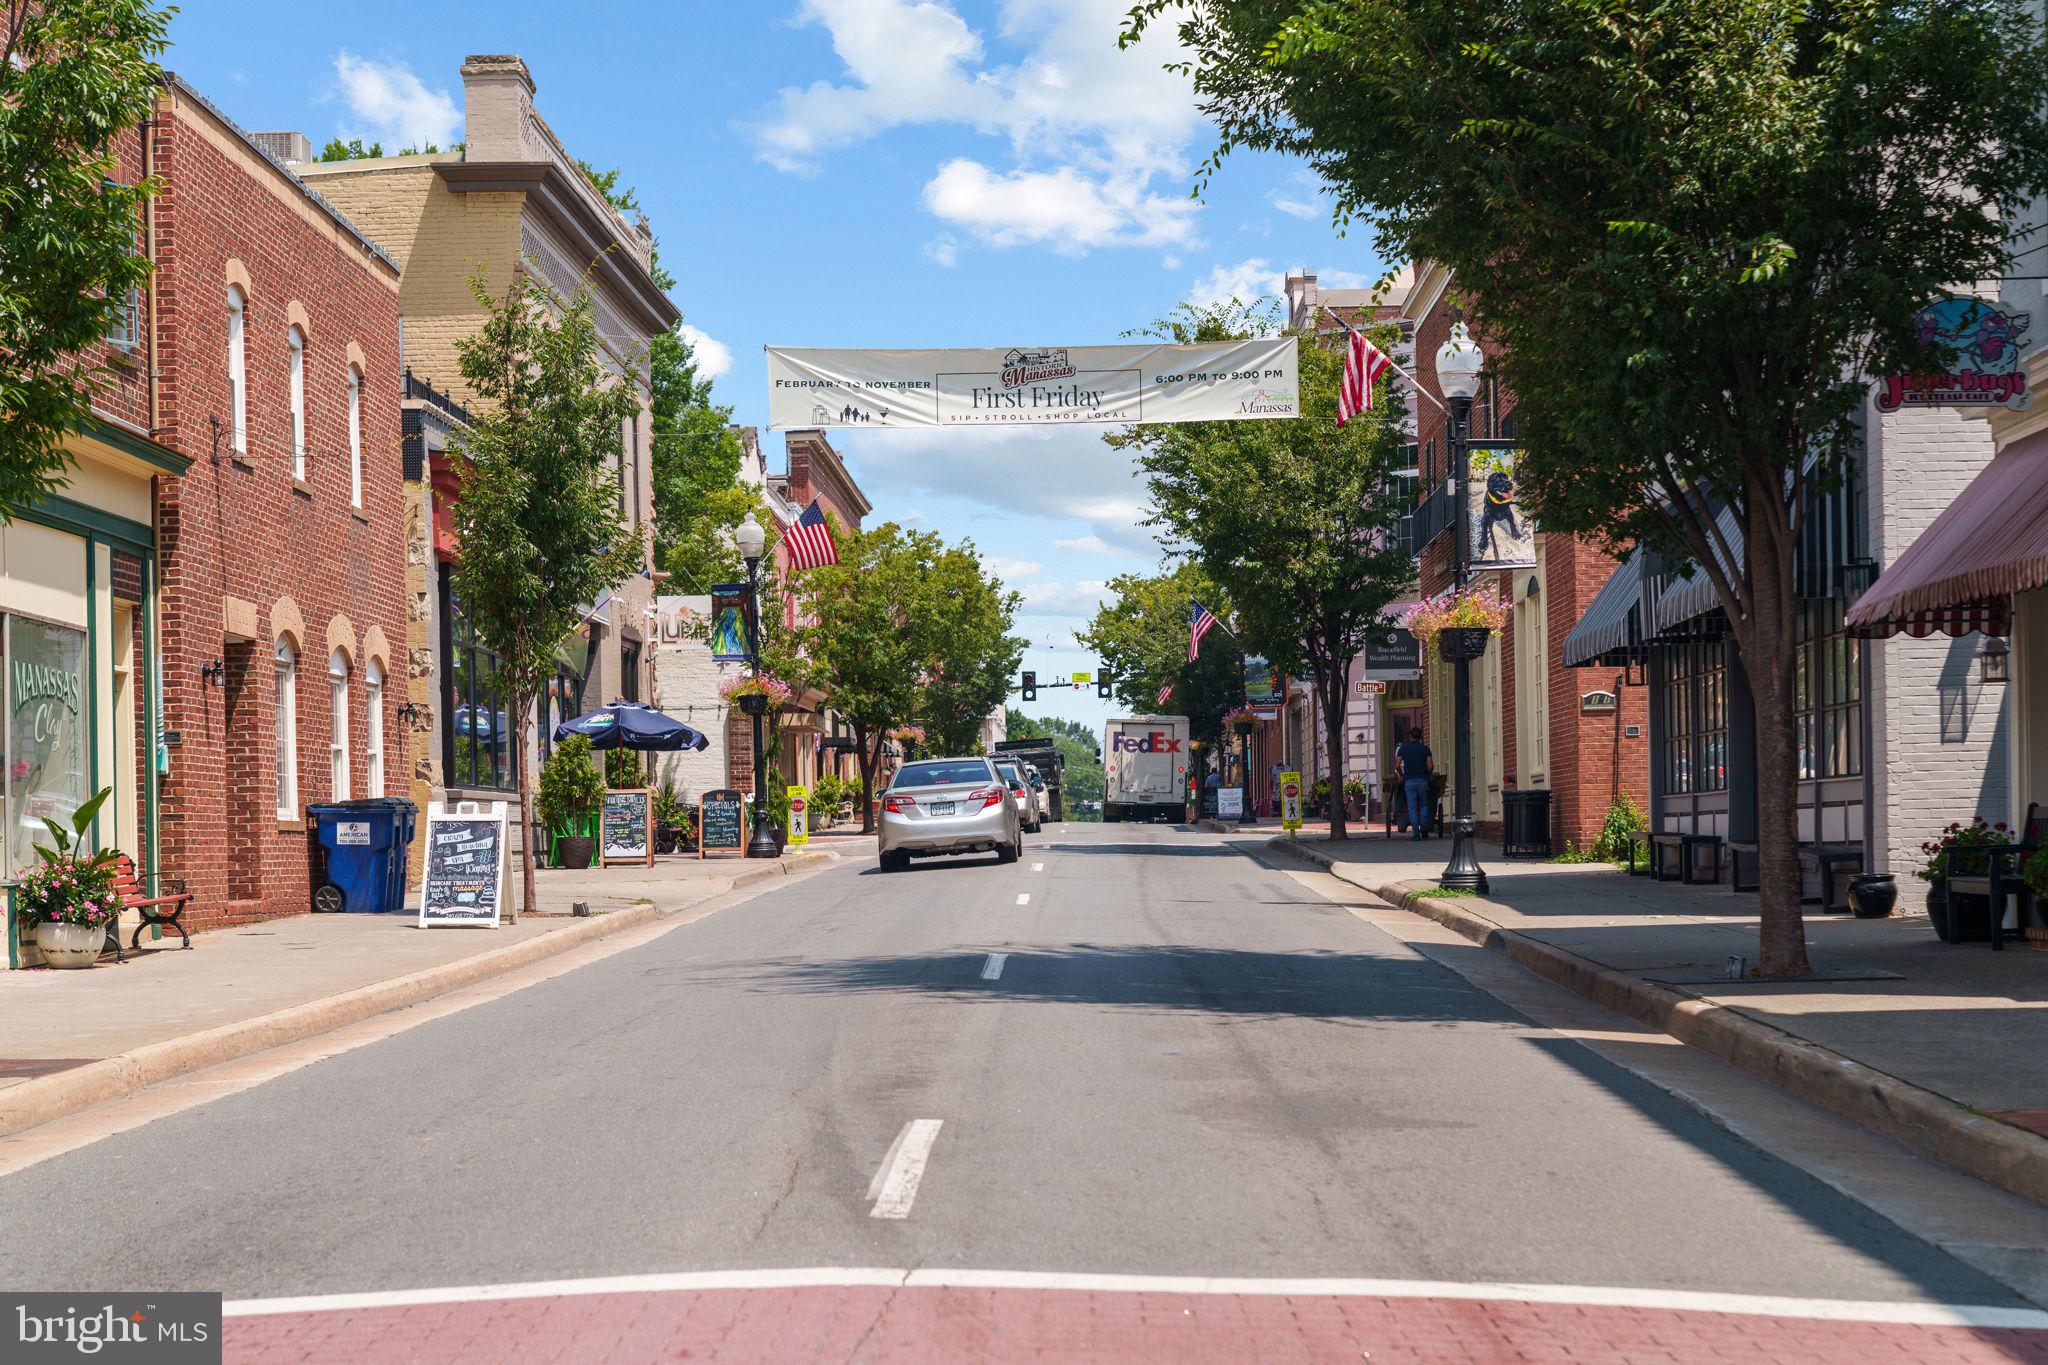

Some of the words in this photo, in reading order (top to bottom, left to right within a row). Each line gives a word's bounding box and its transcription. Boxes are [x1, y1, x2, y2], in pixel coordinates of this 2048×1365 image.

[1027, 362, 1064, 372] HISTORIC
[1002, 365, 1073, 388] Manassas
[1155, 374, 1184, 384] 6:00
[1188, 373, 1207, 382] PM
[1212, 373, 1227, 381] TO
[1231, 370, 1260, 380] 9:00
[1264, 369, 1283, 378] PM
[775, 379, 839, 388] FEBRUARY
[865, 381, 931, 389] NOVEMBER
[1879, 368, 2026, 408] Jierbugs
[972, 386, 1026, 409] First
[1032, 384, 1105, 411] Friday
[1966, 392, 1991, 400] CAFE
[1236, 401, 1293, 414] Manassas
[985, 413, 1032, 421] STROLL
[1087, 411, 1127, 419] LOCAL
[1390, 655, 1416, 663] Planning
[14, 661, 79, 716] MANASSAS
[1357, 683, 1379, 692] Battle
[35, 703, 62, 752] Clay
[1112, 731, 1182, 754] FedEx
[453, 885, 483, 893] massage
